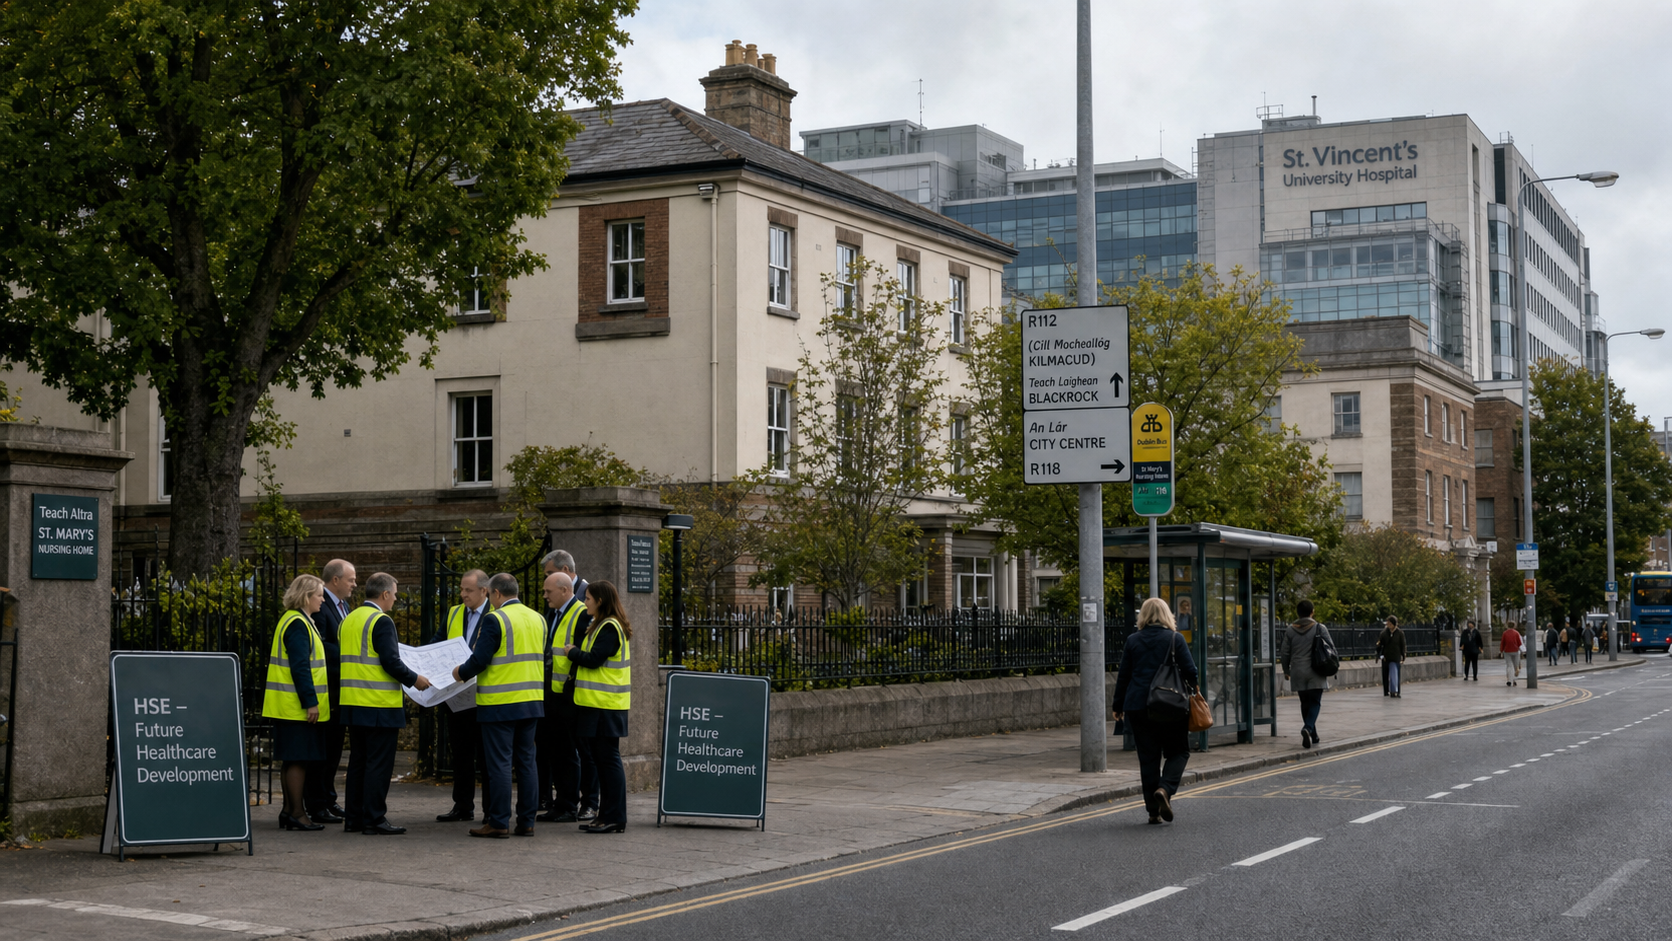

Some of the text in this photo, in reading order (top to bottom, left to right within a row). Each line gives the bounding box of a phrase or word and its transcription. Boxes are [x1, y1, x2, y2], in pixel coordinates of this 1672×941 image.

[1283, 140, 1418, 168] St. Vincent's
[1283, 164, 1417, 187] University Hospital
[1028, 314, 1057, 328] R112
[1028, 340, 1050, 353] (Cill
[1029, 353, 1096, 367] KILMACUD)
[1029, 376, 1098, 388] Teach Laighean
[1029, 391, 1099, 404] BLACKROCK
[1029, 421, 1067, 433] An Lár
[1029, 437, 1106, 450] CITY CENTRE
[1030, 462, 1061, 475] R118
[39, 506, 93, 520] Teach Altra
[38, 526, 94, 541] ST. MARY'S
[38, 545, 94, 555] NURSING HOME
[134, 698, 171, 715] HSE
[680, 706, 710, 721] HSE
[135, 722, 184, 737] Future
[679, 725, 719, 739] Future
[136, 743, 217, 760] Healthcare
[678, 742, 744, 757] Healthcare
[676, 759, 757, 776] Development
[137, 766, 234, 785] Development
